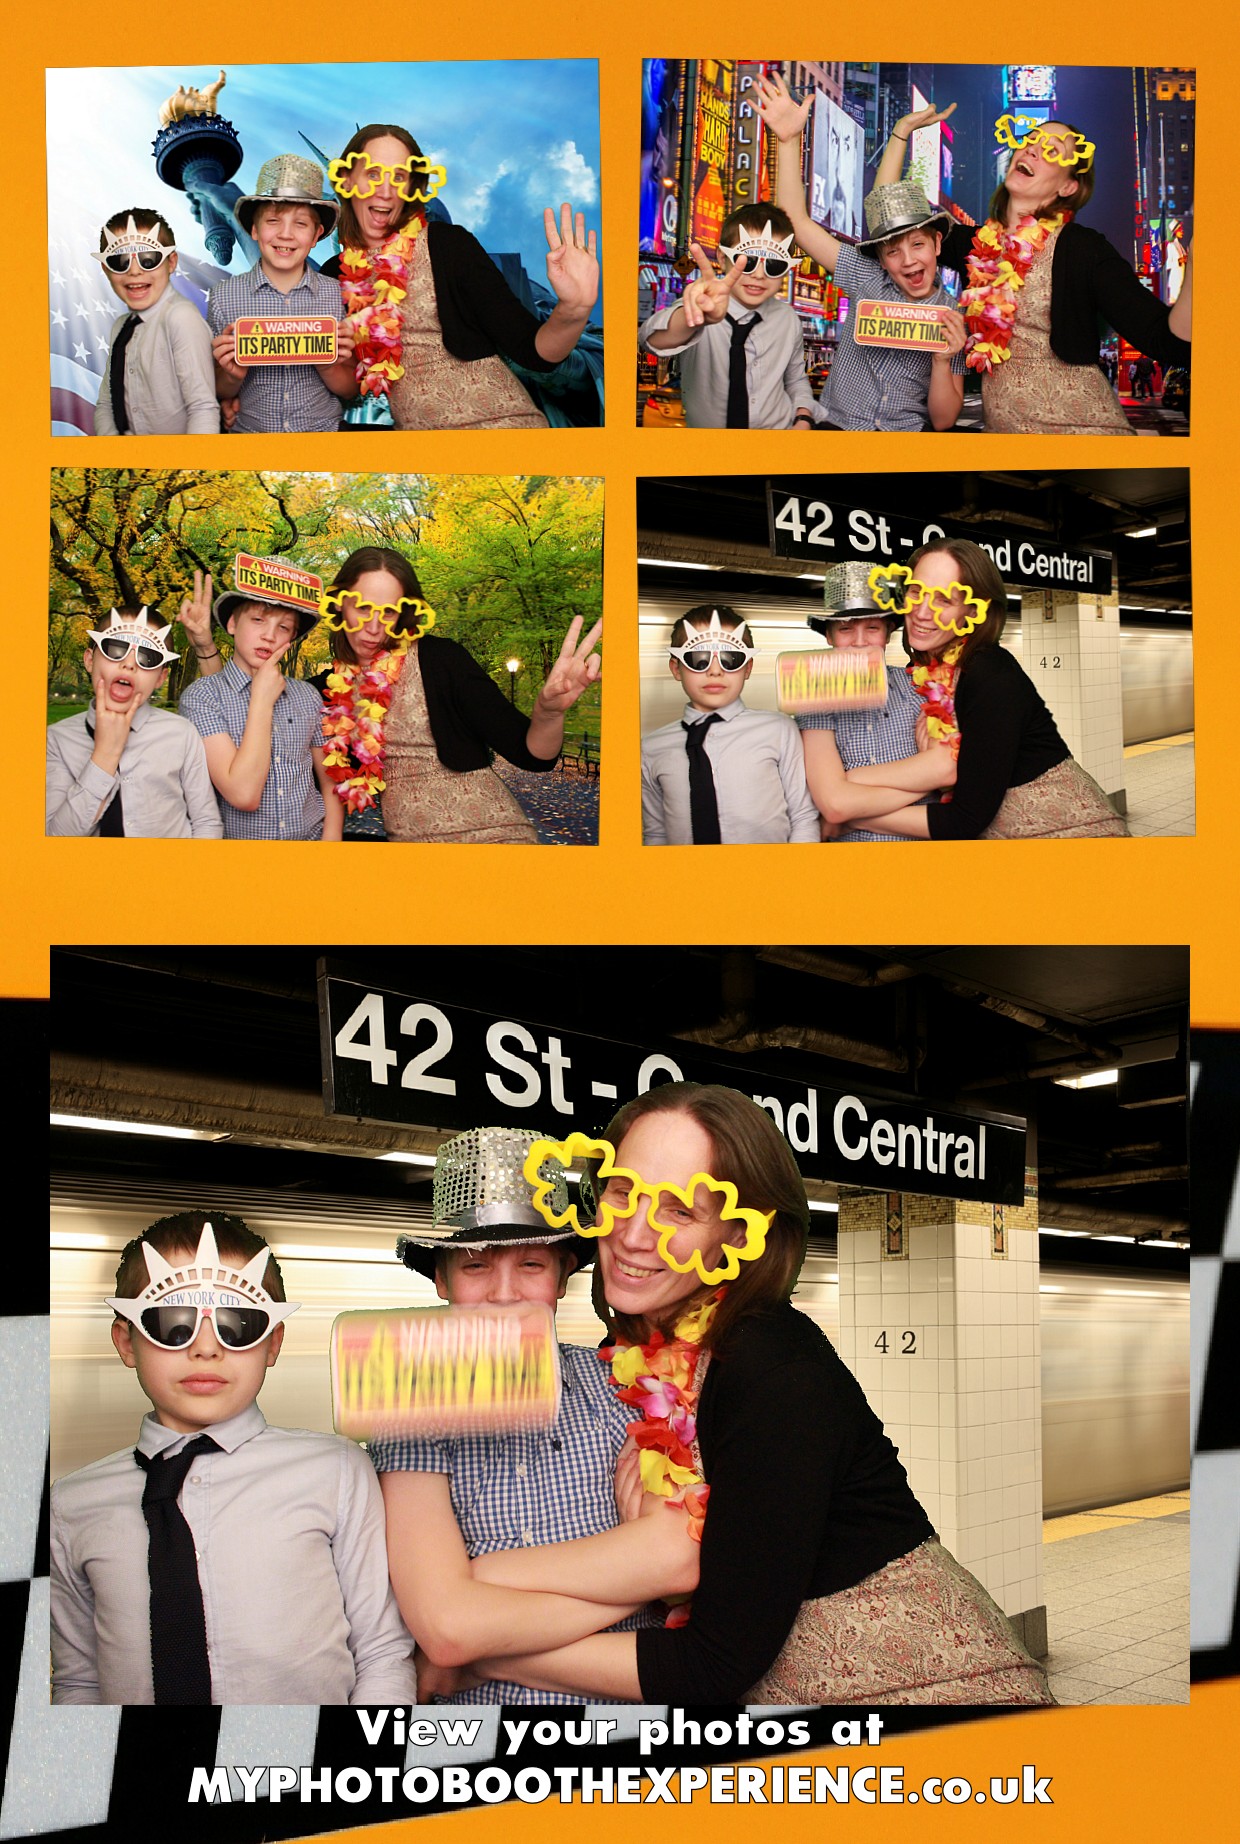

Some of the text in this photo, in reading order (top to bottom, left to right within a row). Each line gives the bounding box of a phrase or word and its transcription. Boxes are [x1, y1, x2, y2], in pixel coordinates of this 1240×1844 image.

[700, 89, 730, 121] HANDS
[703, 113, 727, 151] HARD
[735, 76, 753, 211] PALAC
[700, 144, 726, 170] BODY
[884, 306, 938, 321] WARNING
[264, 321, 322, 333] WARNING
[858, 318, 877, 336] ITS
[878, 320, 917, 339] PARTY
[239, 335, 333, 355] ITS PARTY TIME
[775, 497, 835, 547] 42
[848, 509, 893, 555] St
[1018, 542, 1094, 584] Central
[240, 568, 320, 604] ITS PARTY TIME
[262, 563, 311, 585] WARNING
[1039, 656, 1061, 669] 42
[335, 993, 456, 1096] 42
[485, 1021, 574, 1115] St
[833, 1095, 986, 1180] Central
[162, 1291, 241, 1306] NEW YORK CITY
[874, 1330, 917, 1354] 42
